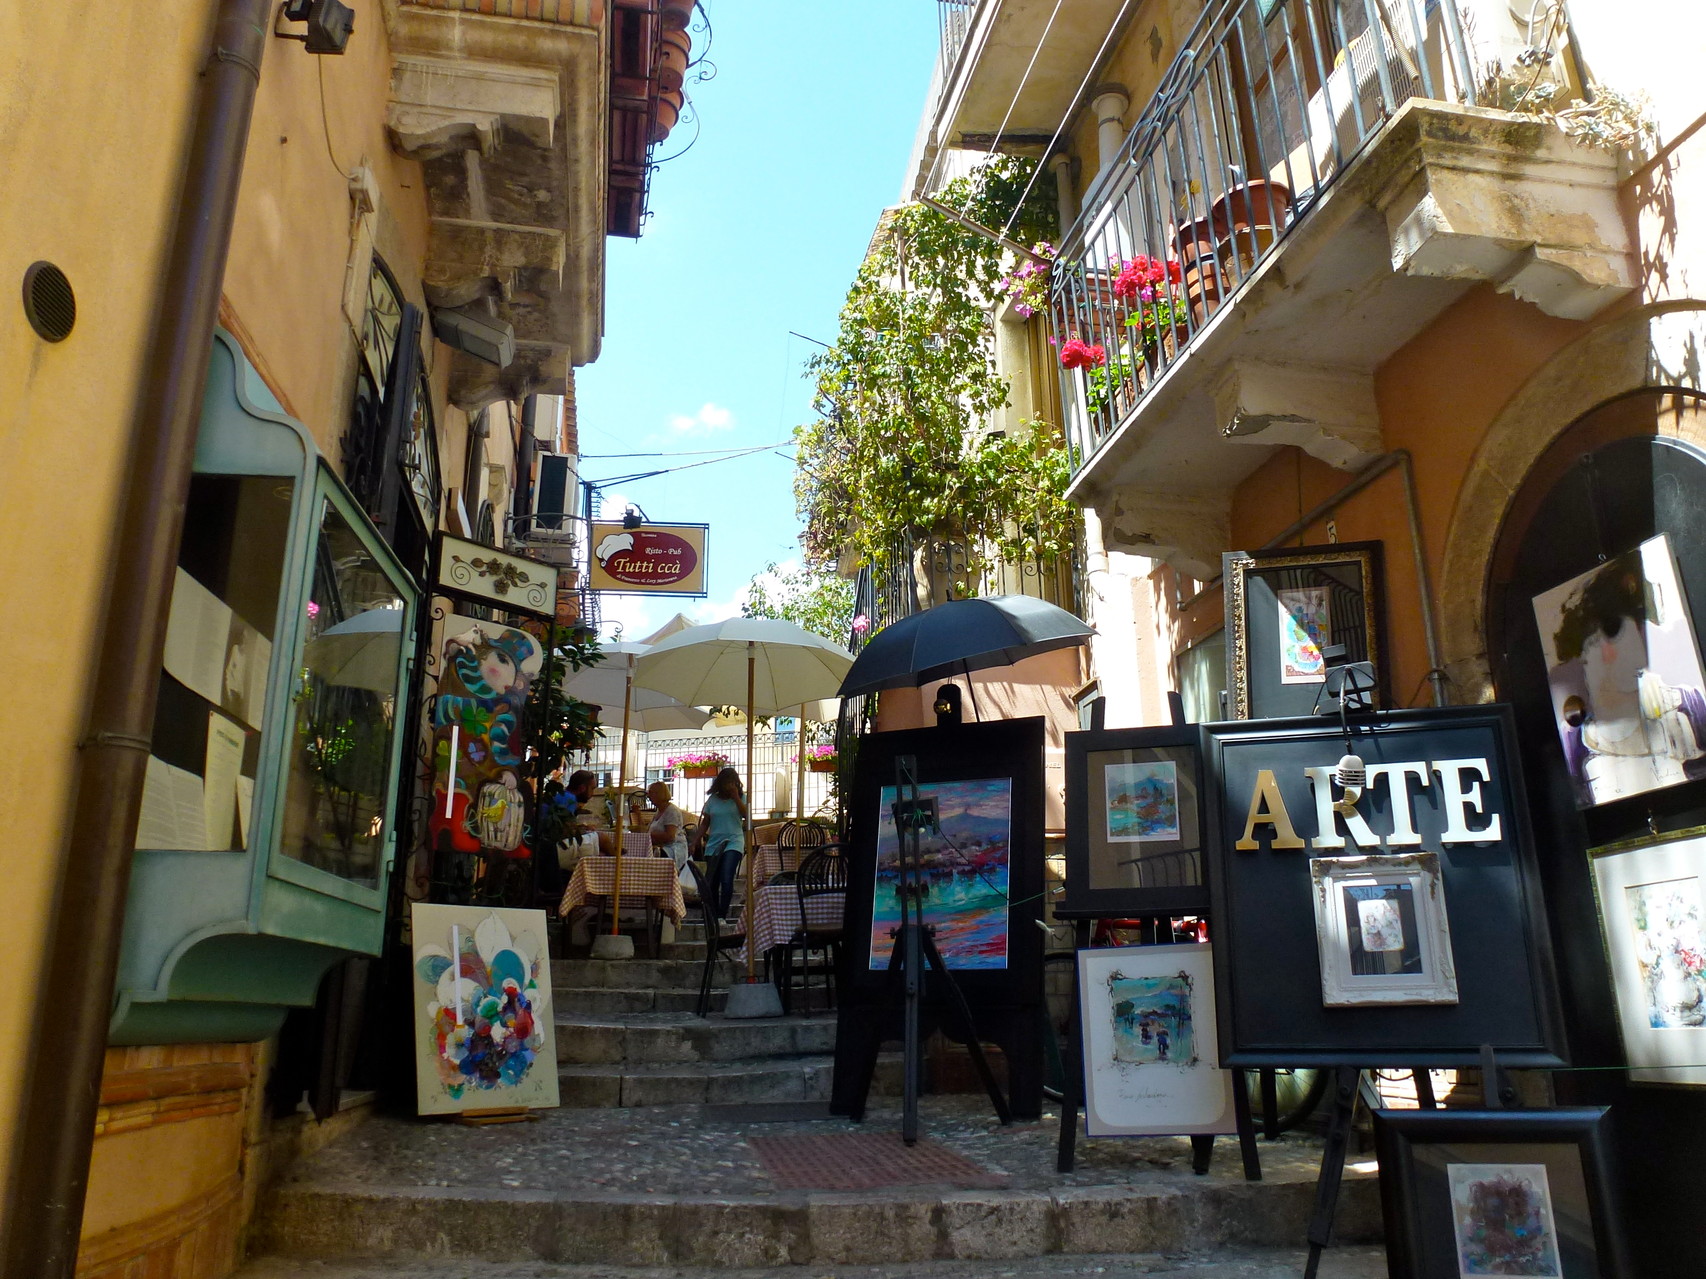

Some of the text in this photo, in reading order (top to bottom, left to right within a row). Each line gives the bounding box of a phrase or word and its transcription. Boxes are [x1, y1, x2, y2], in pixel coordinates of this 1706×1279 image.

[645, 547, 663, 555] Risto
[614, 558, 681, 574] Tutti ccà
[1235, 757, 1502, 850] ARTE
